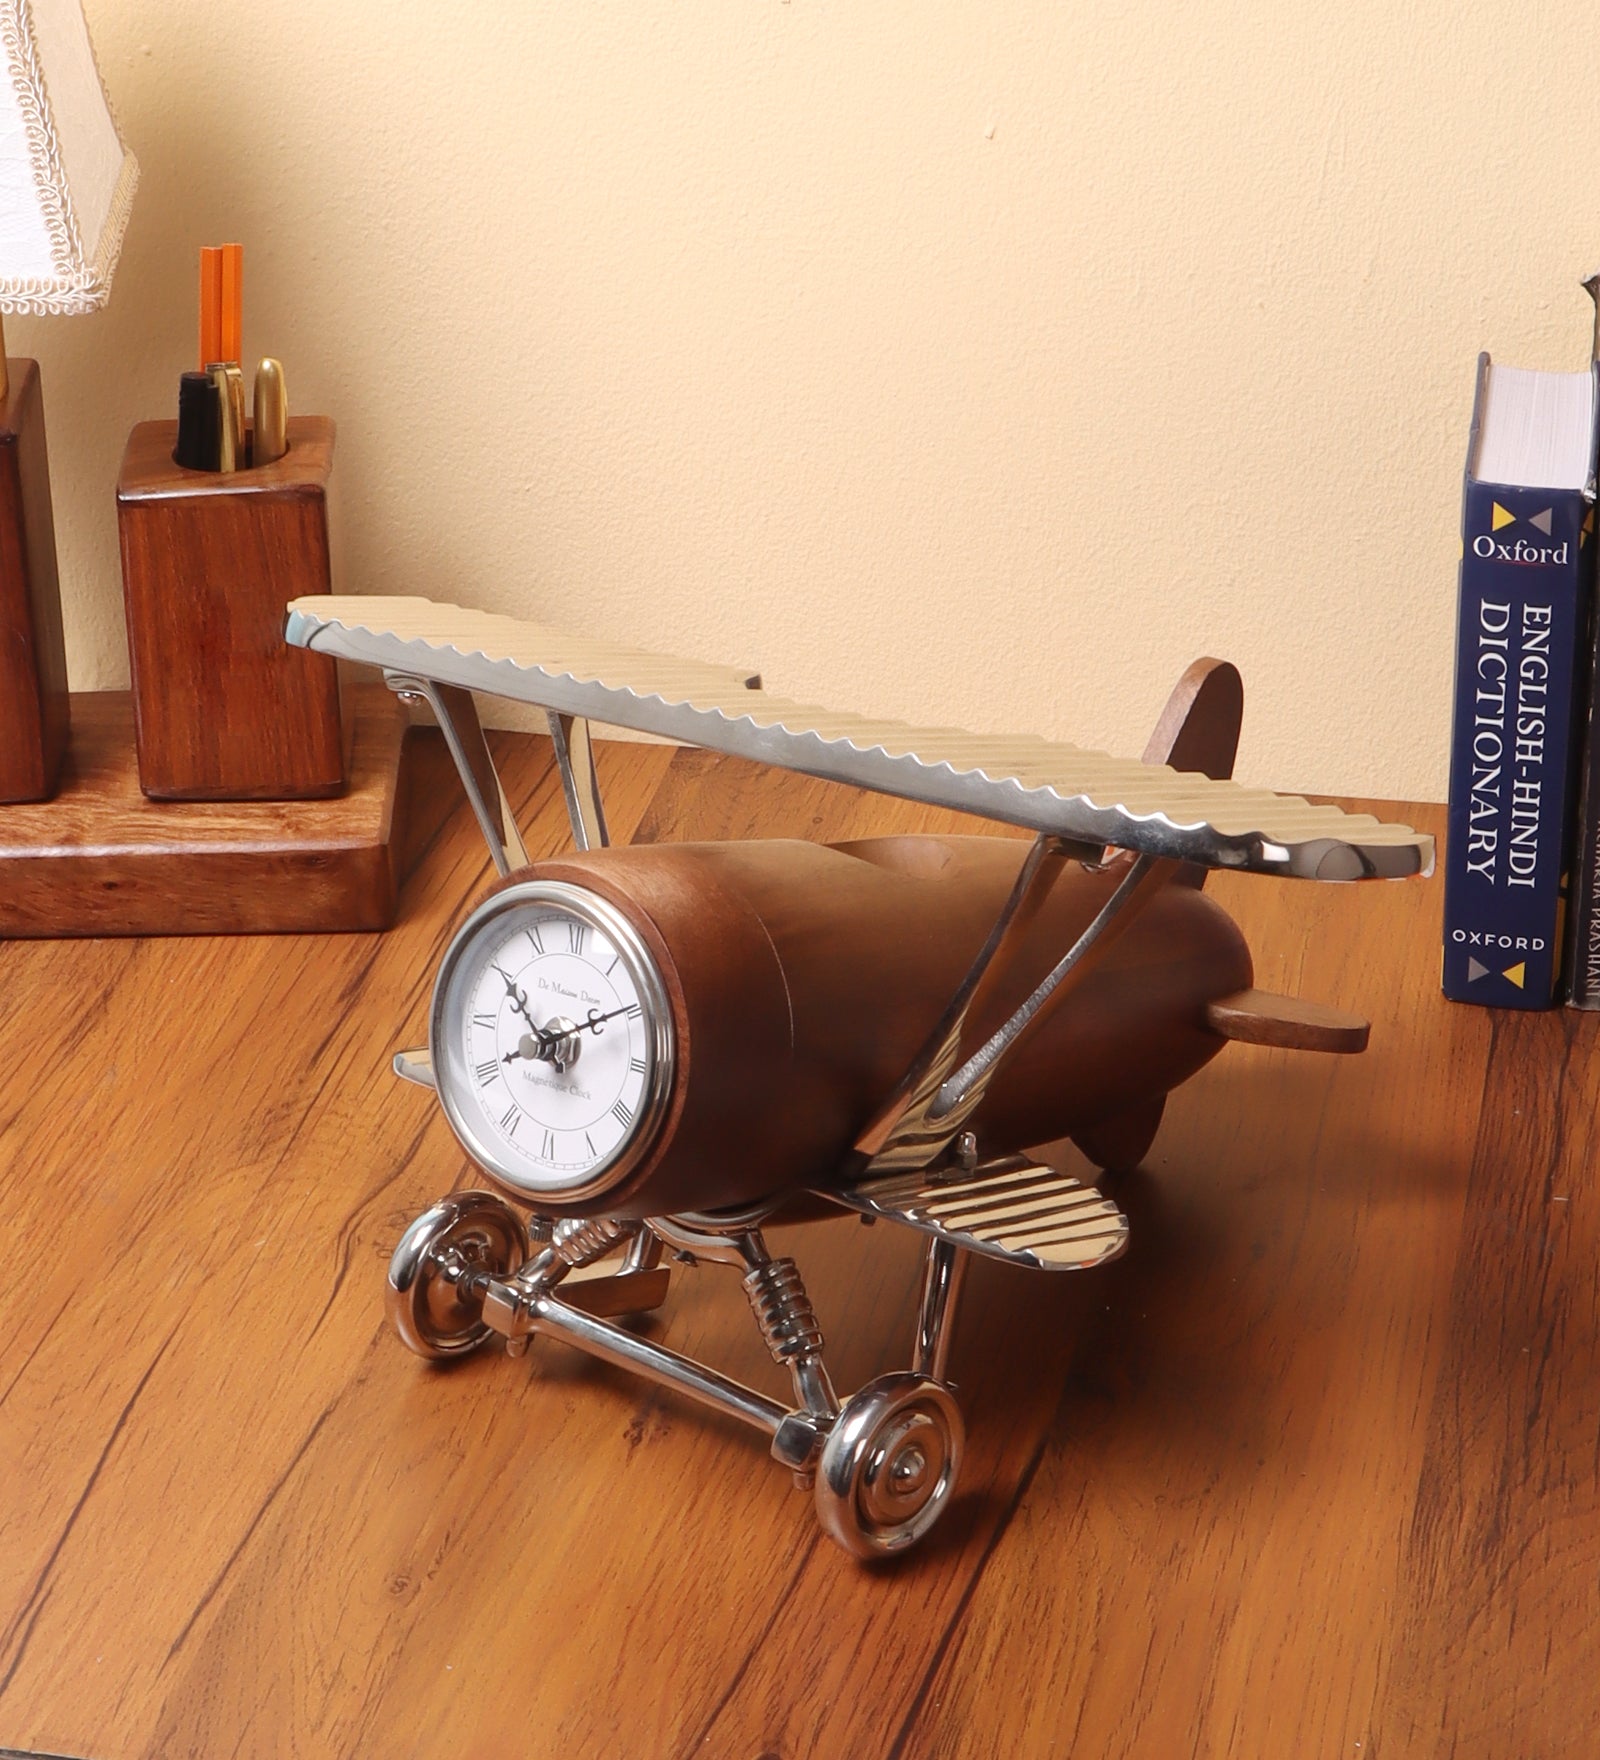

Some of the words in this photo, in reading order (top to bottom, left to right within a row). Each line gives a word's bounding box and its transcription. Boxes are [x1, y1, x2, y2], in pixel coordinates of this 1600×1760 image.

[1473, 535, 1568, 565] Oxford
[1467, 598, 1511, 885] DICTIONARY
[1507, 603, 1552, 888] ENGLISH-HINDI
[1452, 929, 1545, 951] OXFORD
[1585, 908, 1600, 997] PRASHANT
